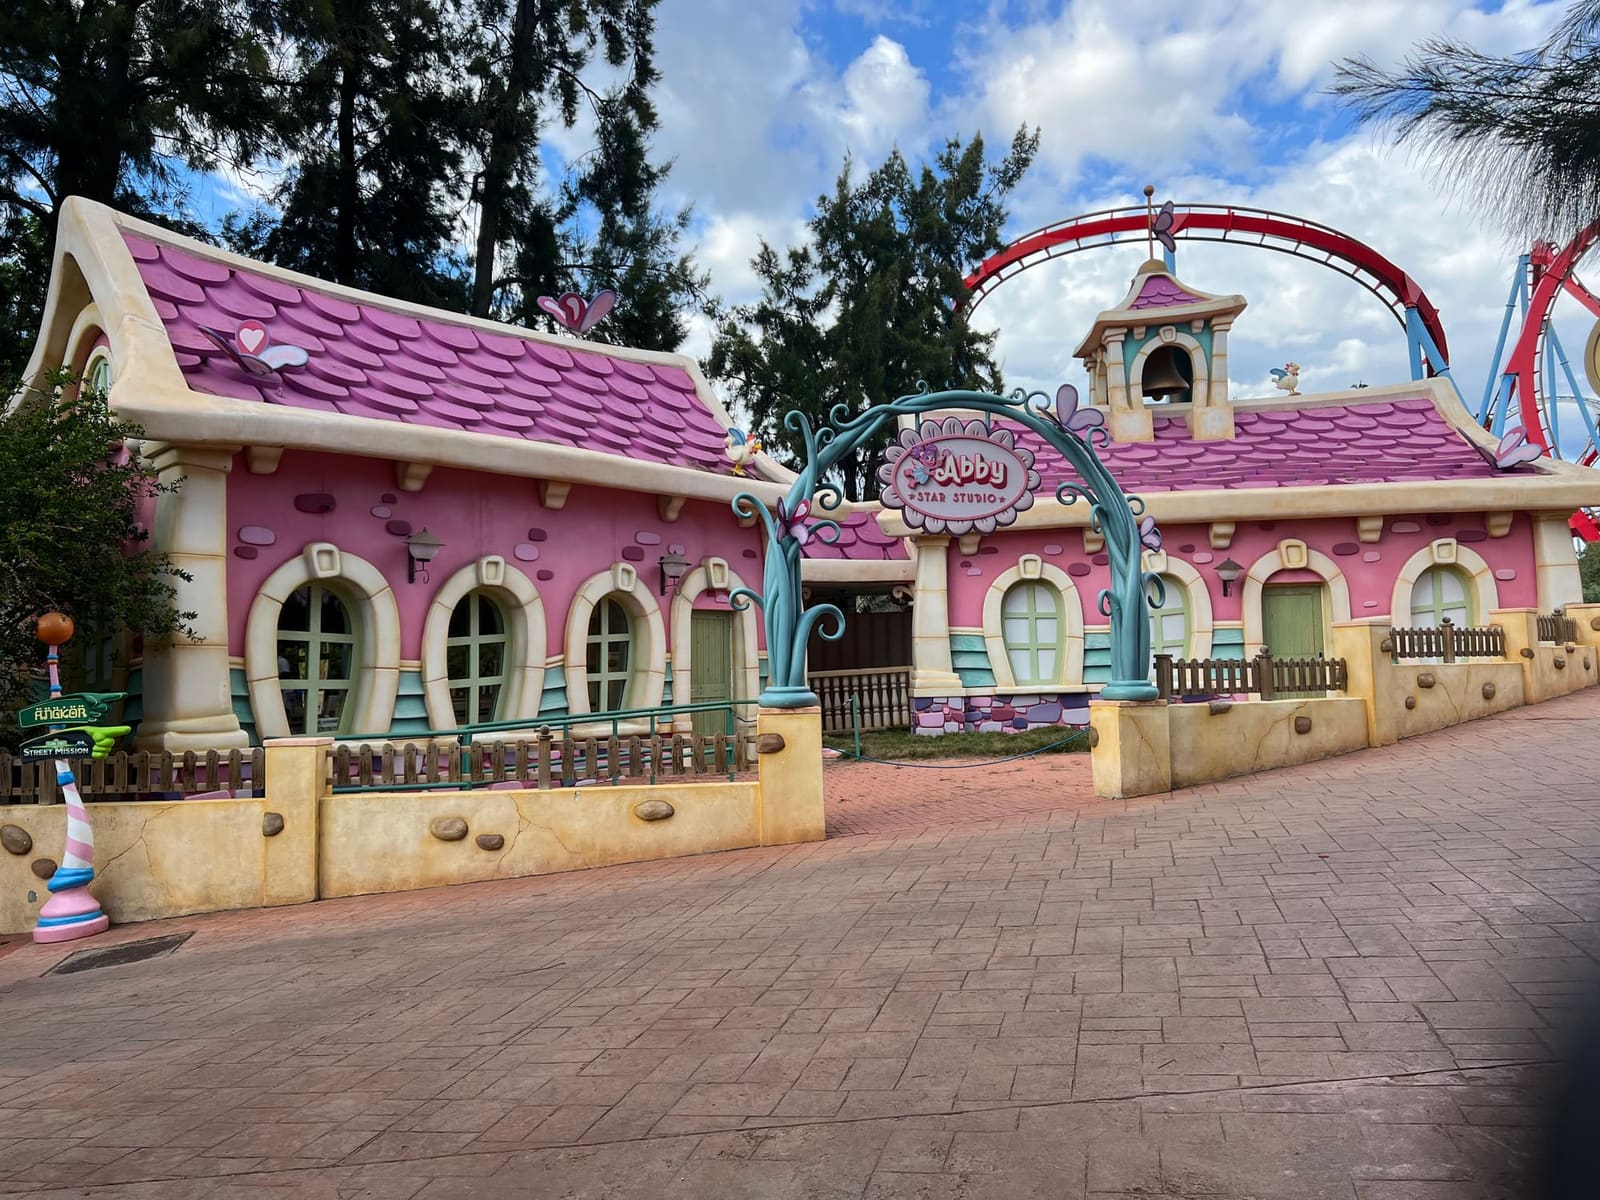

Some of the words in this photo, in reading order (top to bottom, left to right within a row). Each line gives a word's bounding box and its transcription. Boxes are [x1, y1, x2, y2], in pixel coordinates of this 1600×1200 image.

[934, 453, 1007, 489] Abby
[917, 491, 945, 503] STAR
[952, 492, 997, 503] STUDIO
[23, 747, 53, 757] STREET
[54, 747, 89, 755] MISSION
